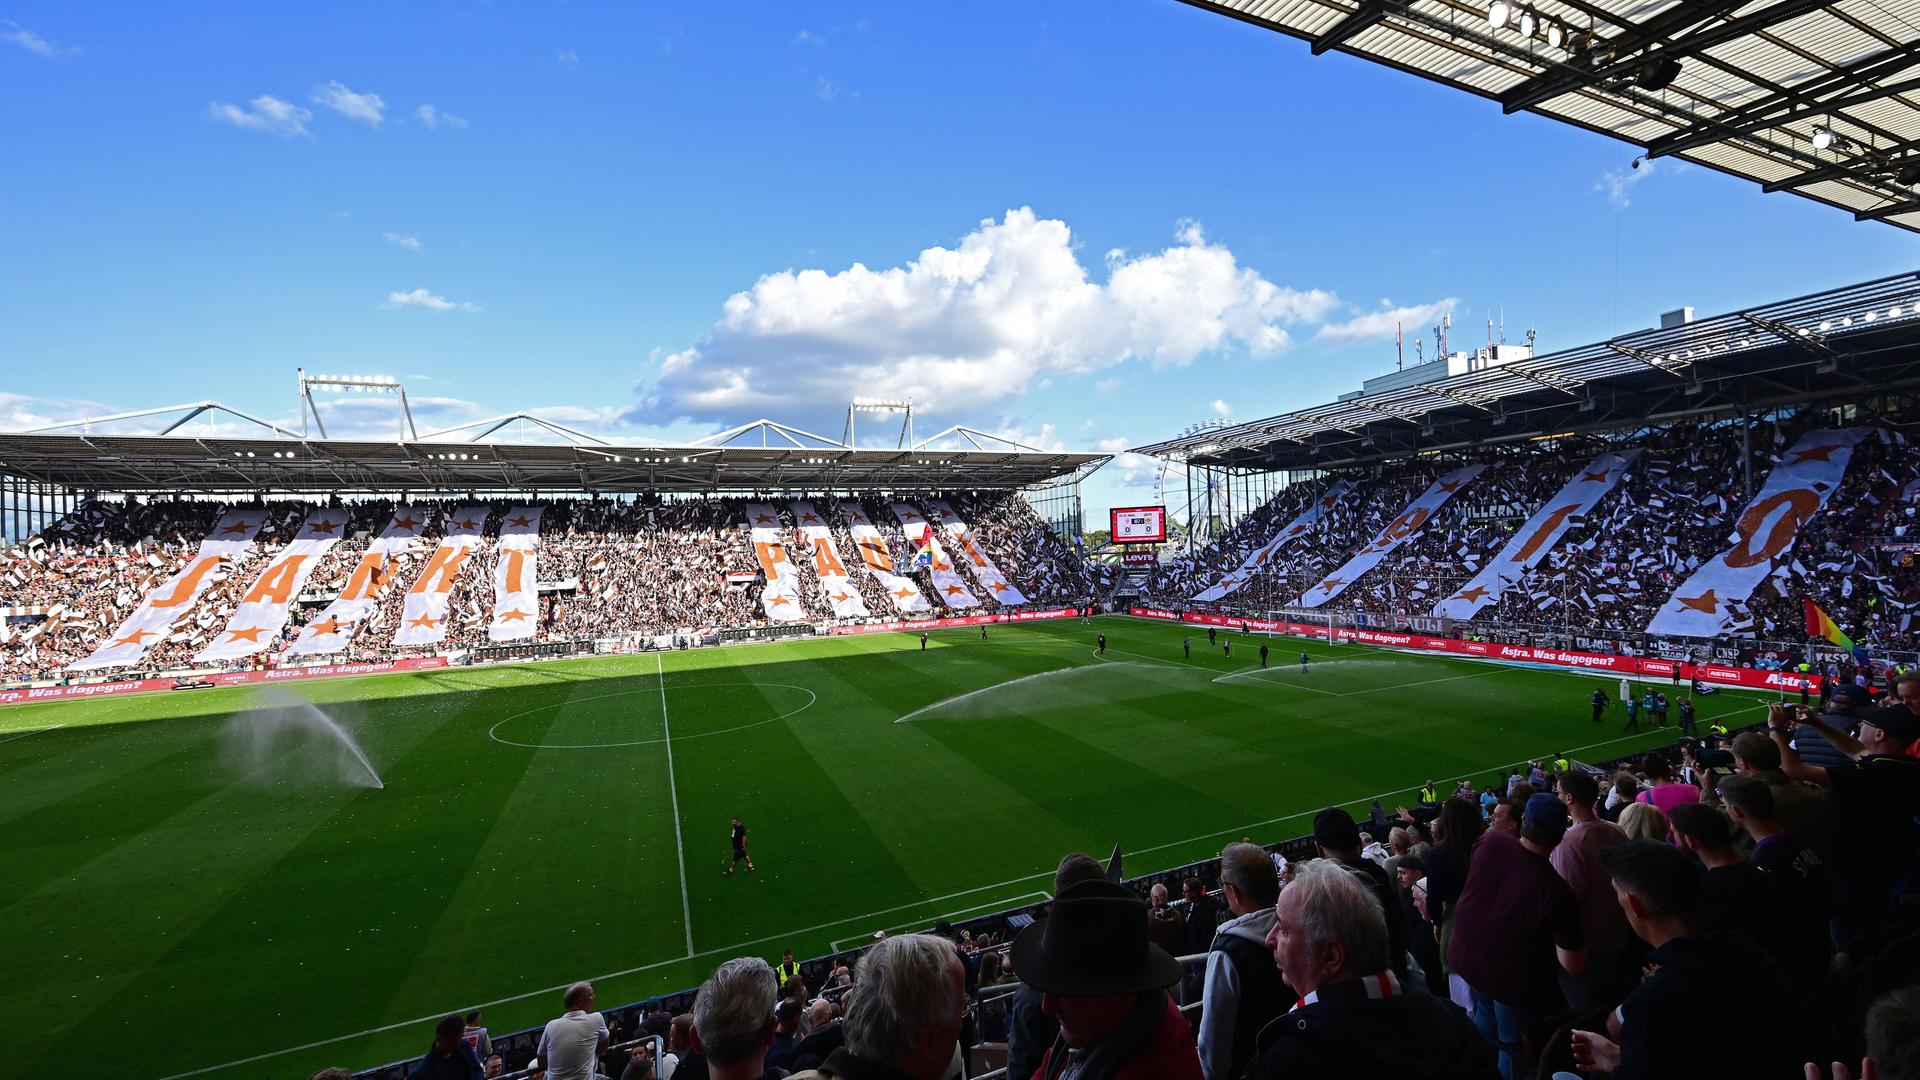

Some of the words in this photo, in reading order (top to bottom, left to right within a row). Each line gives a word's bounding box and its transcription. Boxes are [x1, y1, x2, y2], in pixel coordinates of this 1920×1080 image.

[999, 612, 1019, 621] Asra.
[1358, 631, 1374, 640] Was
[1374, 633, 1411, 644] dagegen?
[1501, 646, 1531, 658] Astra.
[1533, 649, 1556, 660] Was
[1557, 652, 1615, 666] dagegen?
[265, 669, 304, 679] Astra.
[307, 666, 334, 675] Was
[1646, 663, 1671, 671] ASTRA
[1709, 670, 1737, 679] ASTRA
[28, 687, 62, 698] Was
[66, 681, 143, 695] dagegen?
